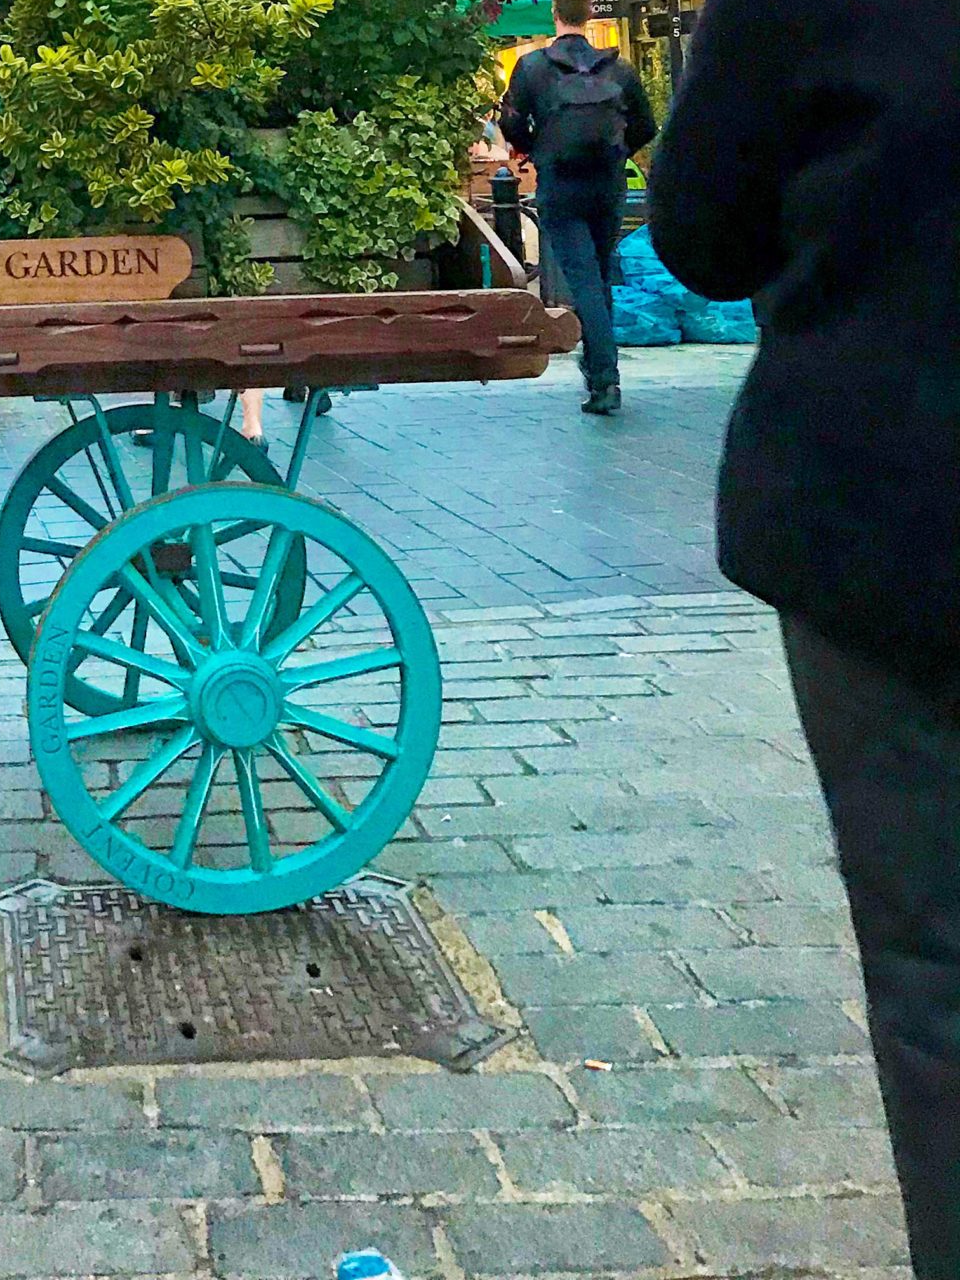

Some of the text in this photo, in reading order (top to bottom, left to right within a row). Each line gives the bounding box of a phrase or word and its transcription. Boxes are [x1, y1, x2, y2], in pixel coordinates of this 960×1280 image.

[5, 247, 160, 280] GARDEN
[39, 626, 196, 901] COVENT GARDEN
